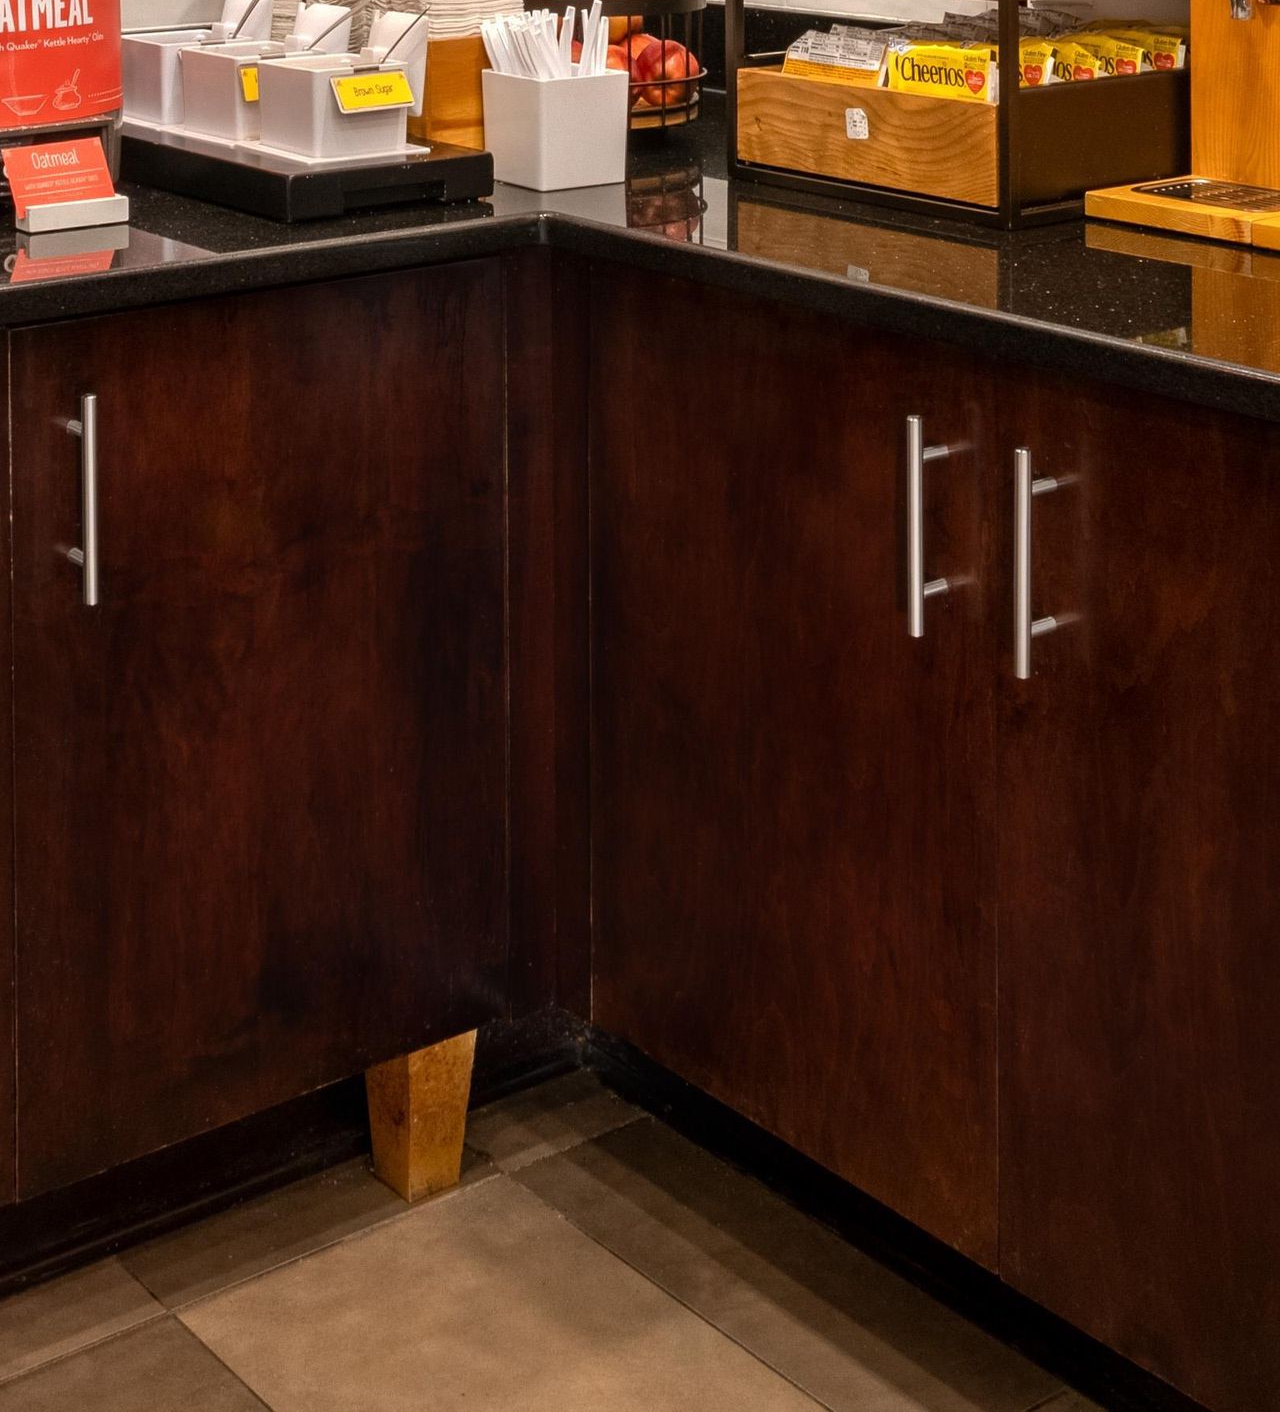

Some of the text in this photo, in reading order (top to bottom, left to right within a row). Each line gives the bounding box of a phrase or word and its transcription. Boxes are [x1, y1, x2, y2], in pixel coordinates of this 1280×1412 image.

[901, 56, 965, 88] Cheerios
[353, 84, 393, 97] Brown Sugar
[31, 148, 80, 170] Oatmeal
